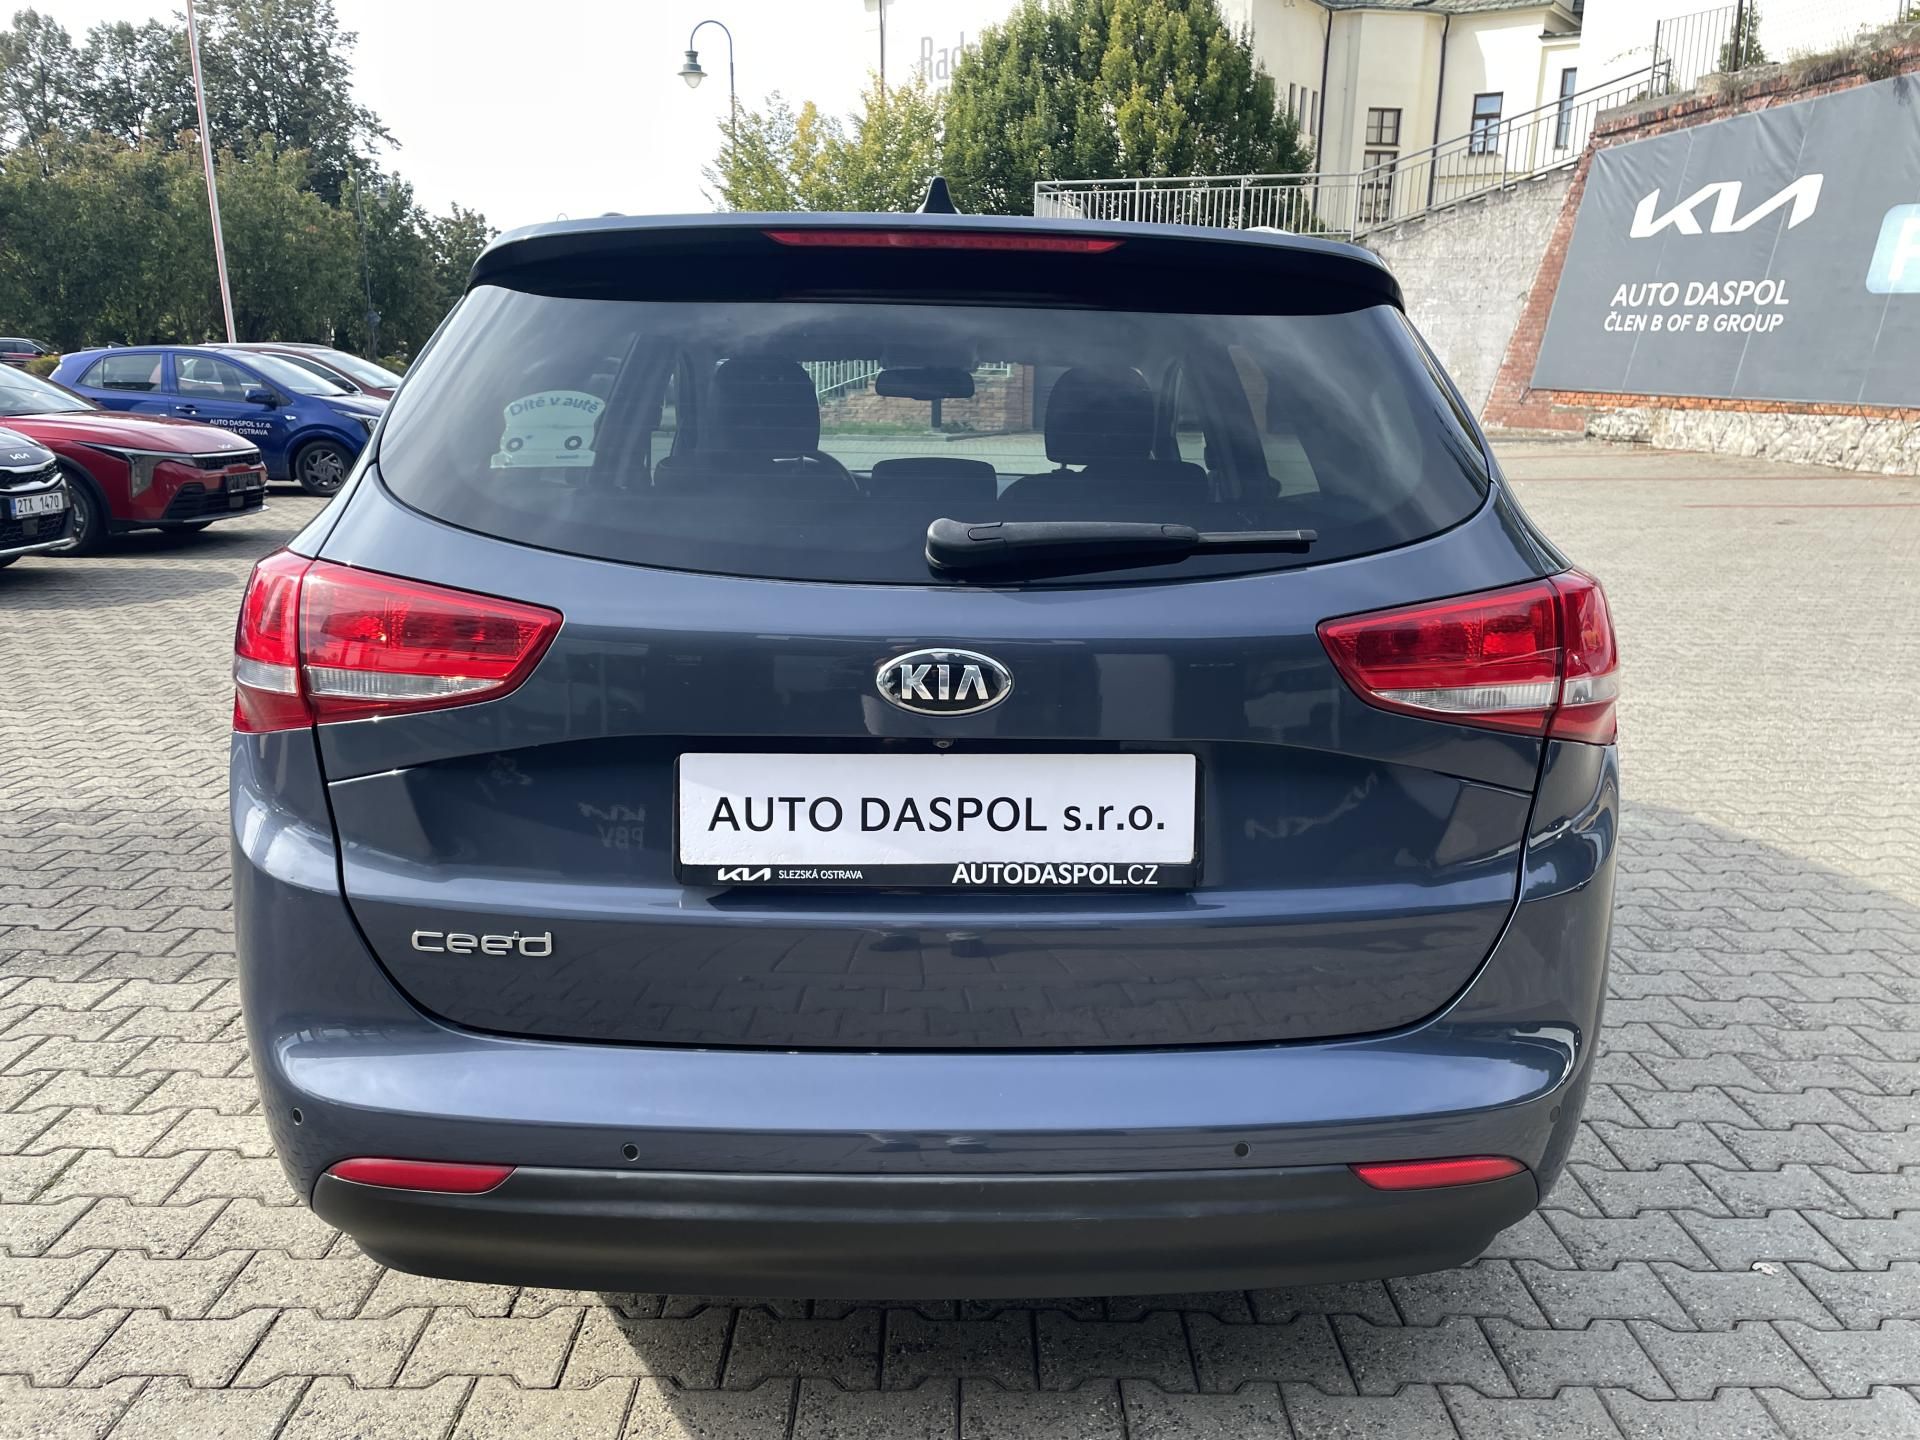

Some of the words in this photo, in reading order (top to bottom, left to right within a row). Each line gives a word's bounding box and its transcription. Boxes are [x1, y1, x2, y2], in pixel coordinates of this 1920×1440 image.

[1629, 173, 1824, 238] KIA
[1610, 281, 1680, 307] AUTO
[1683, 279, 1789, 306] DASPOL
[1604, 310, 1648, 332] ČLEN
[1650, 314, 1663, 332] B
[1666, 314, 1693, 332] OF
[1695, 314, 1709, 332] B
[1713, 313, 1784, 332] GROUP
[550, 397, 562, 406] v
[562, 397, 599, 414] autě
[209, 418, 228, 426] AUTO
[229, 419, 255, 427] DASPOL
[238, 428, 268, 436] OSTRAVA
[17, 497, 34, 514] 2TX
[40, 495, 60, 510] 1470
[900, 664, 989, 700] KIA
[707, 796, 843, 832] AUTO
[861, 796, 1048, 832] DASPOL
[1063, 804, 1165, 832] s.r.o.
[717, 867, 771, 881] KIA
[778, 869, 818, 880] SLEZSKÁ
[820, 870, 863, 880] OSTRAVA
[951, 863, 1159, 885] AUTODASPOL.CZ
[411, 929, 552, 957] cee'd
